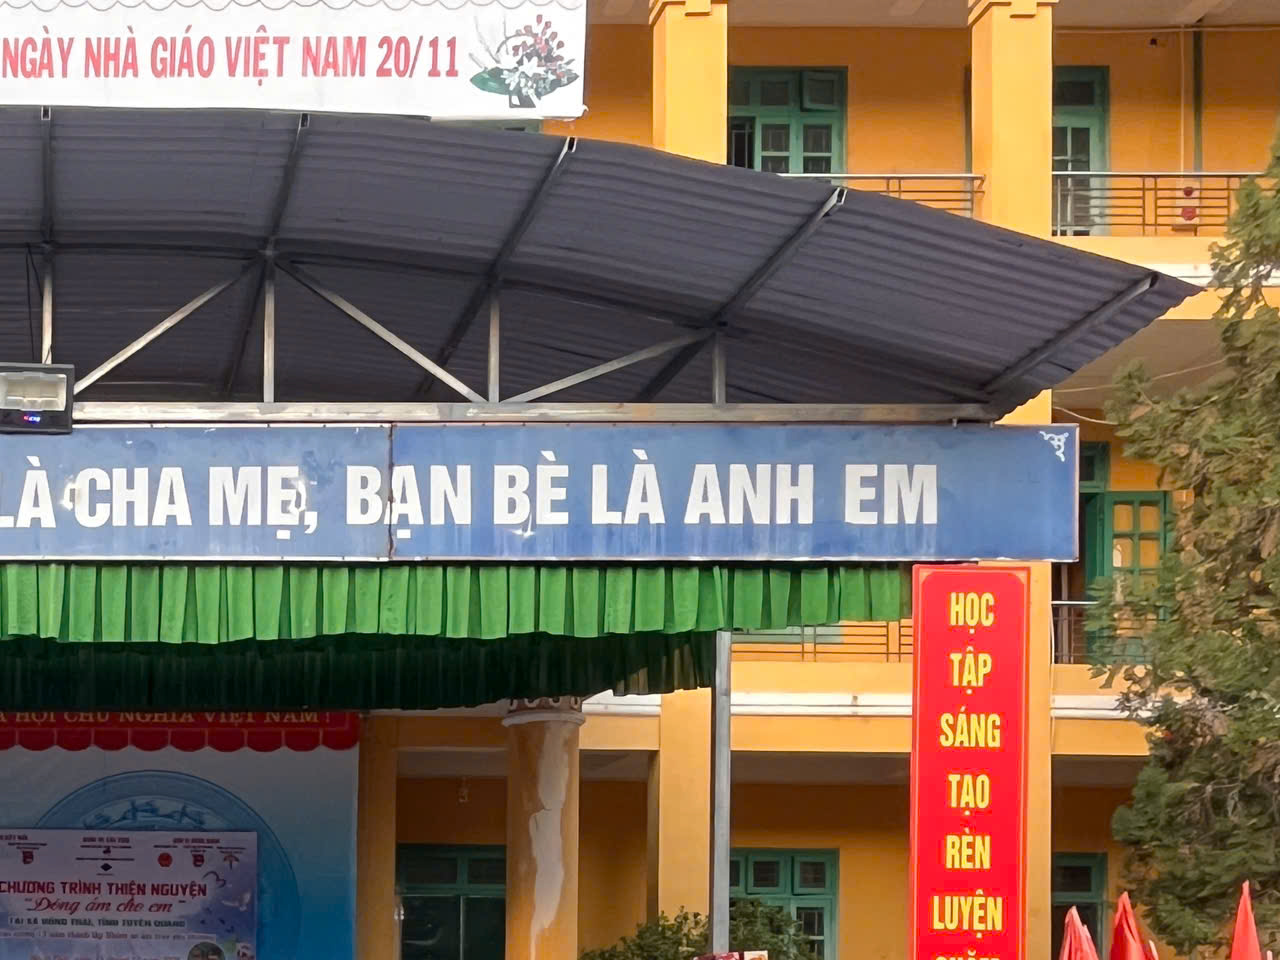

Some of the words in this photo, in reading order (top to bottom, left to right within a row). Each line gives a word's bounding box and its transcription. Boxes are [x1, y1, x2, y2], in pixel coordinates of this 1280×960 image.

[2, 38, 72, 79] NGÀY
[84, 38, 139, 77] NHÀ
[151, 36, 215, 78] GIÁO
[226, 36, 290, 80] VIỆT
[302, 36, 366, 77] NAM
[375, 36, 458, 78] 20/11
[86, 465, 193, 527] CHA
[210, 464, 319, 540] MẸ,
[346, 464, 471, 540] BẠN
[494, 450, 568, 526] BÈ
[592, 449, 665, 525] LÀ
[684, 464, 813, 526] ANH
[845, 464, 937, 525] EM
[950, 591, 995, 634] HỌC
[950, 645, 992, 694] TẬP
[939, 705, 1001, 748] SÁNG
[948, 774, 990, 816] TẠO
[946, 828, 991, 870] RÈN
[933, 889, 1003, 938] LUYỆN
